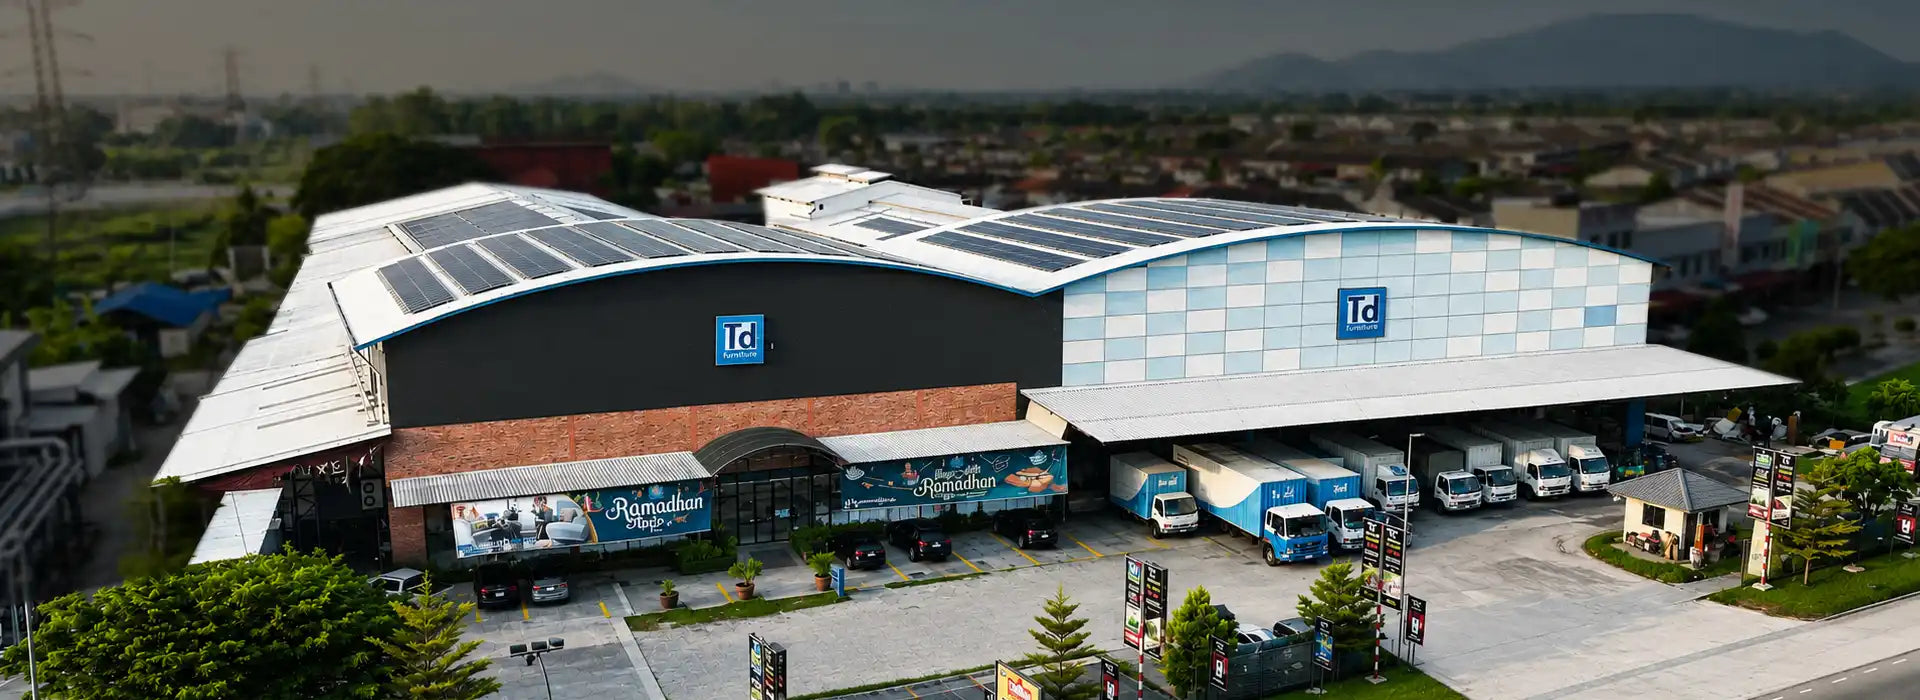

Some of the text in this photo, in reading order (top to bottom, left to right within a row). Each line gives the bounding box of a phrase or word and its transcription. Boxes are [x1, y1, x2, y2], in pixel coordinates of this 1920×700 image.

[1347, 294, 1379, 323] Td
[723, 322, 757, 350] Td
[605, 493, 703, 523] Ramadhan
